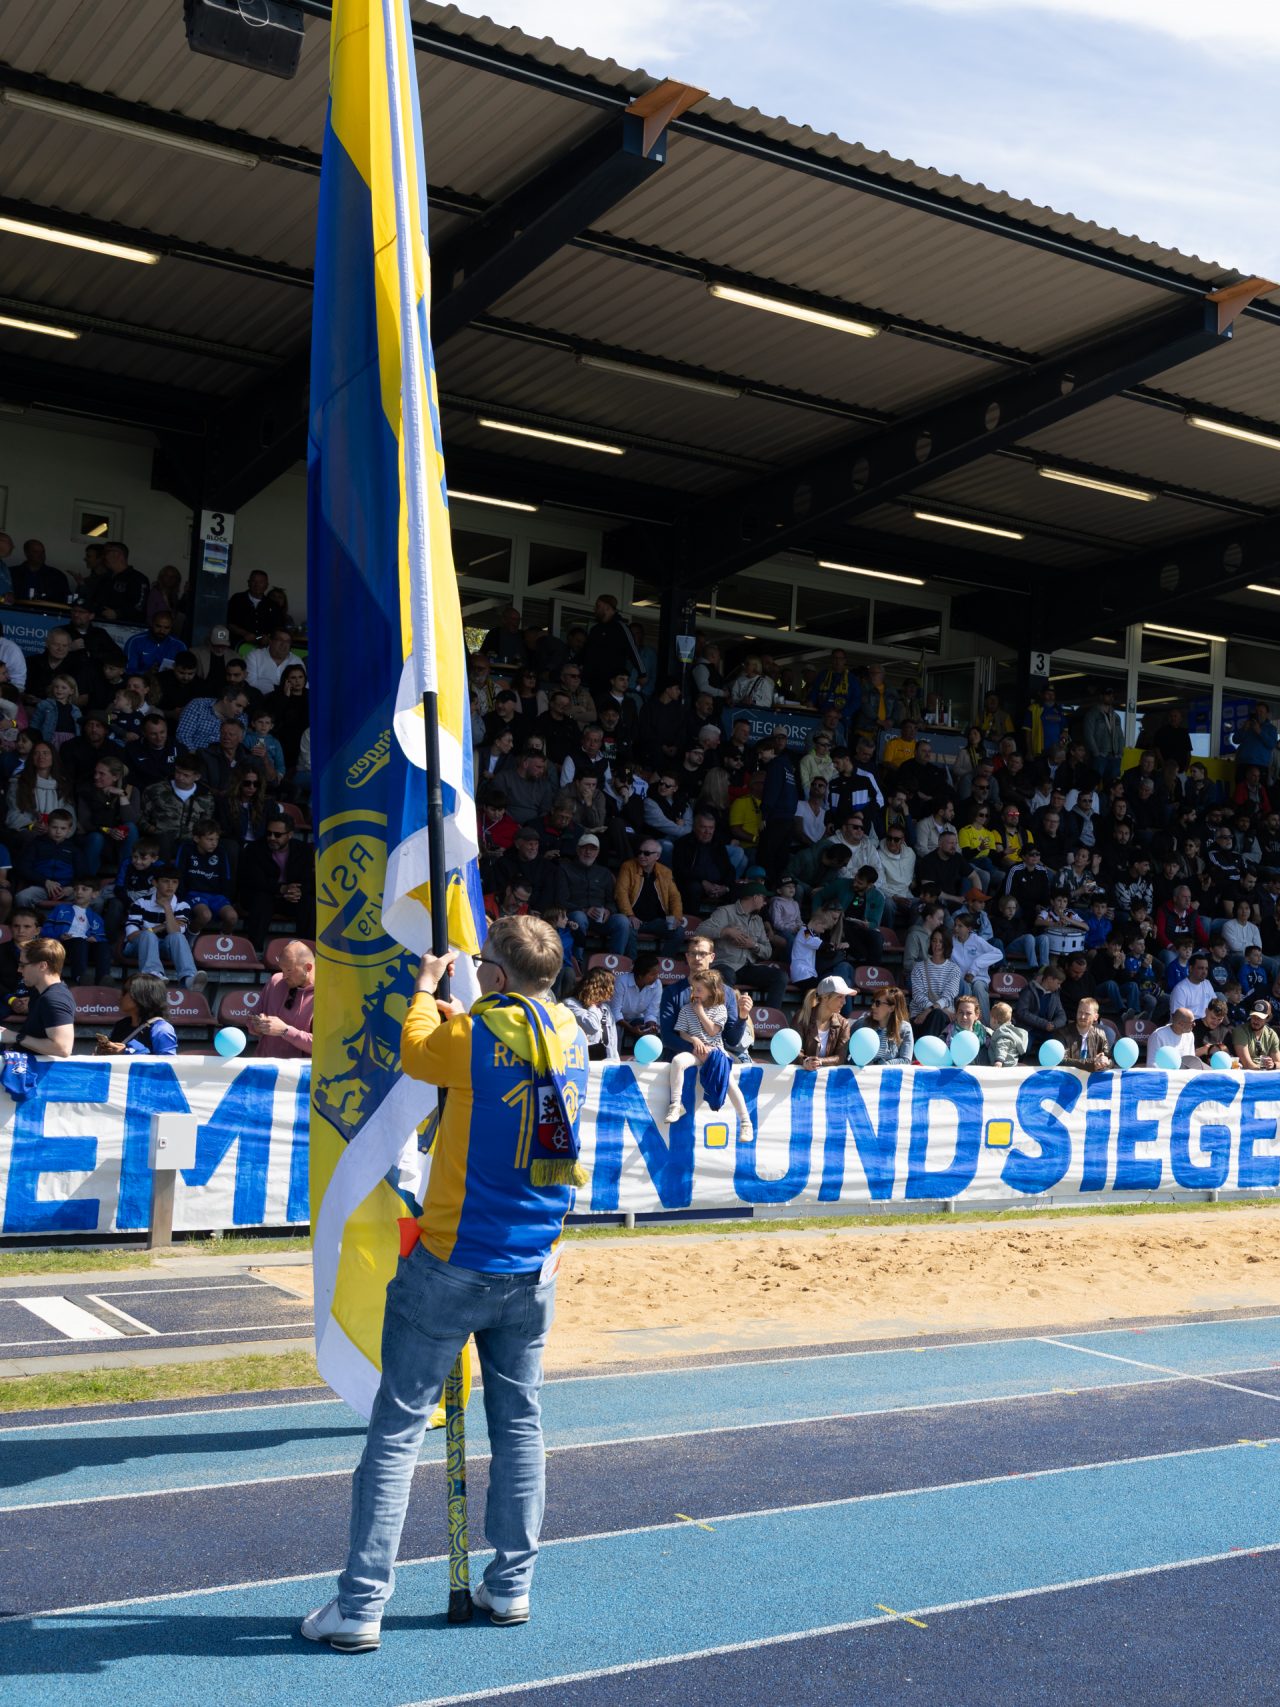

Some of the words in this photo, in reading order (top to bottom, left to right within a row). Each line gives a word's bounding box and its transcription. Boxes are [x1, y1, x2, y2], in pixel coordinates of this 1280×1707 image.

[210, 512, 225, 537] 3
[1036, 653, 1045, 671] 3
[203, 952, 247, 961] vodafone
[75, 1004, 120, 1013] odafone
[733, 1066, 984, 1203] UND
